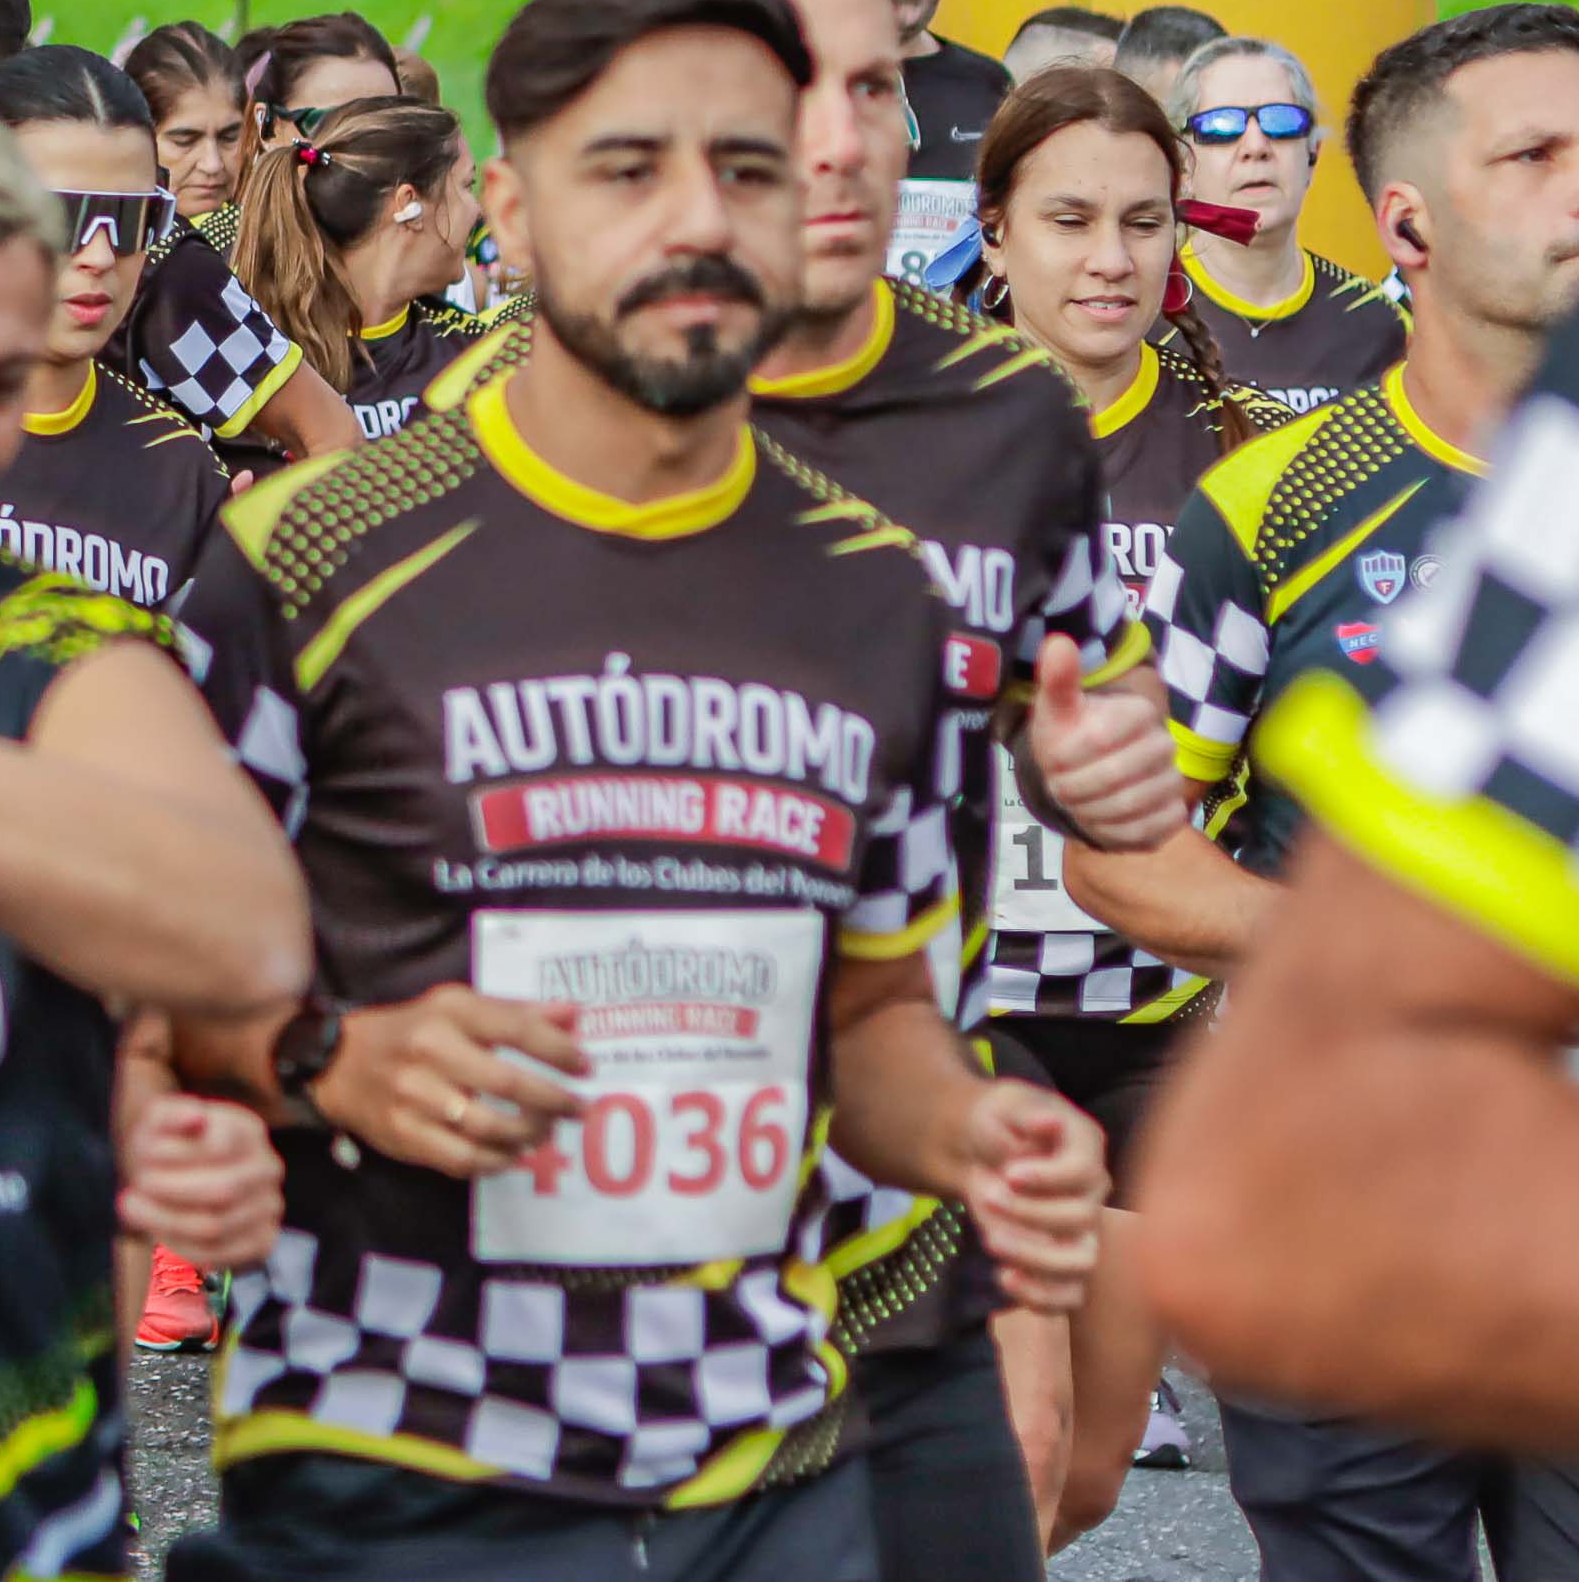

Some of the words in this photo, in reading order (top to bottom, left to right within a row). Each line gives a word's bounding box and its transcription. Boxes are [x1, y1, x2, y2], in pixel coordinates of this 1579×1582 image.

[442, 651, 876, 805] AUTÓDROMO
[522, 783, 705, 842] RUNNING
[713, 784, 826, 857] RACE
[434, 858, 473, 892] La
[476, 859, 579, 889] Carrera
[584, 853, 616, 886] de
[617, 854, 652, 888] los
[654, 856, 742, 892] Clubes
[745, 862, 787, 895] del
